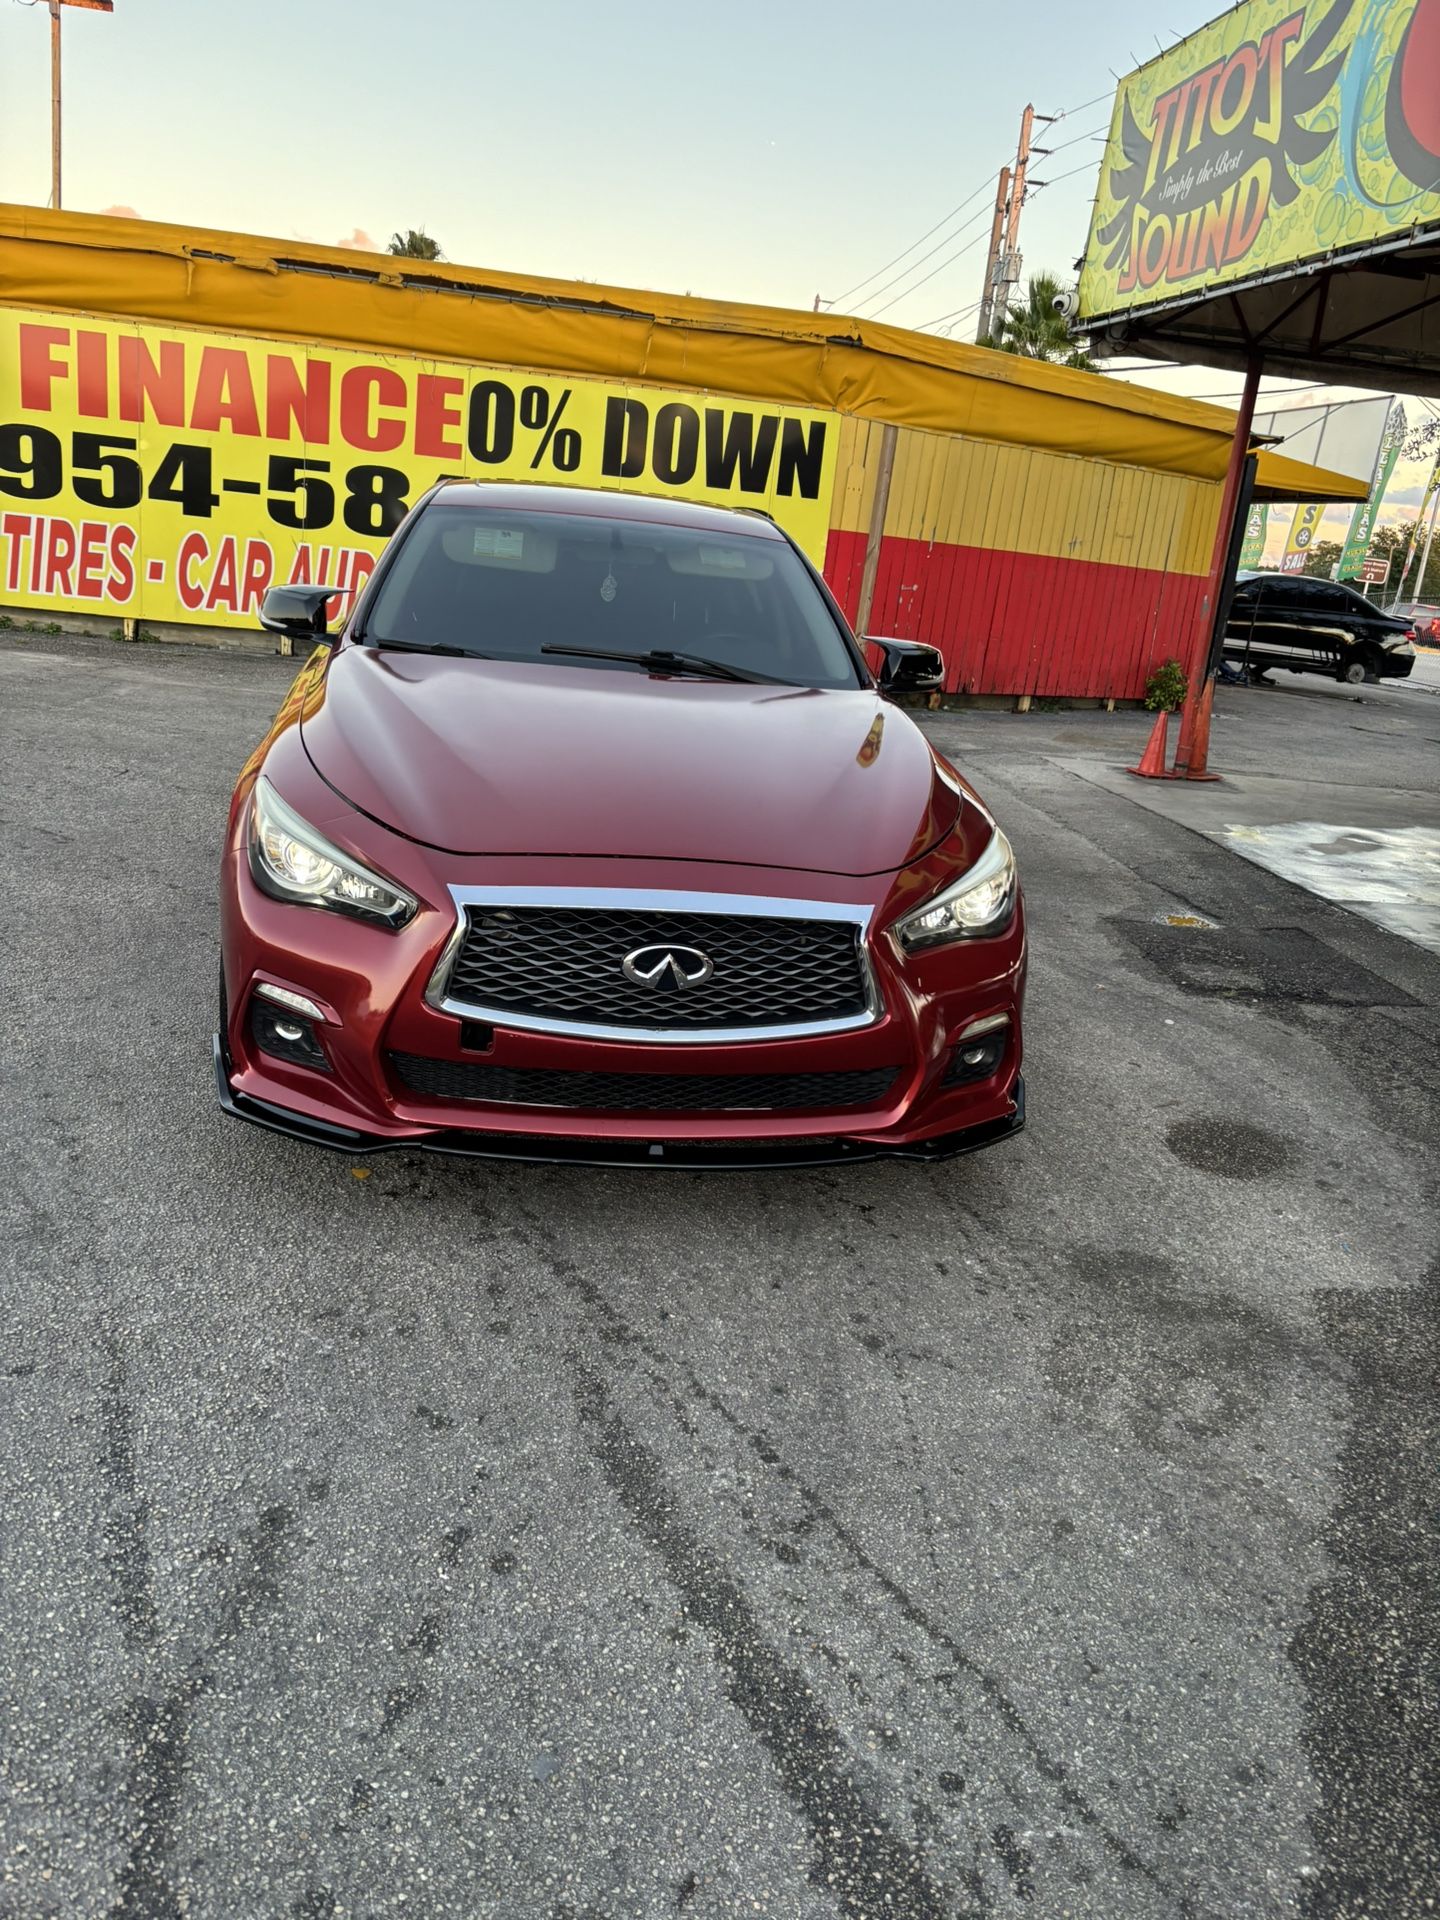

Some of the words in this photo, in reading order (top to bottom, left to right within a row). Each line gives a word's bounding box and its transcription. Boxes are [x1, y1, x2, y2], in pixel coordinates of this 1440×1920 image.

[1117, 157, 1273, 291] SOUND
[1159, 167, 1195, 204] Simply
[1196, 159, 1214, 185] the
[1213, 148, 1243, 178] Best
[19, 323, 464, 460] FINANCE
[468, 380, 582, 472] 0%
[601, 396, 827, 499] DOWN
[2, 512, 137, 603] TIRES
[178, 532, 275, 614] CAR
